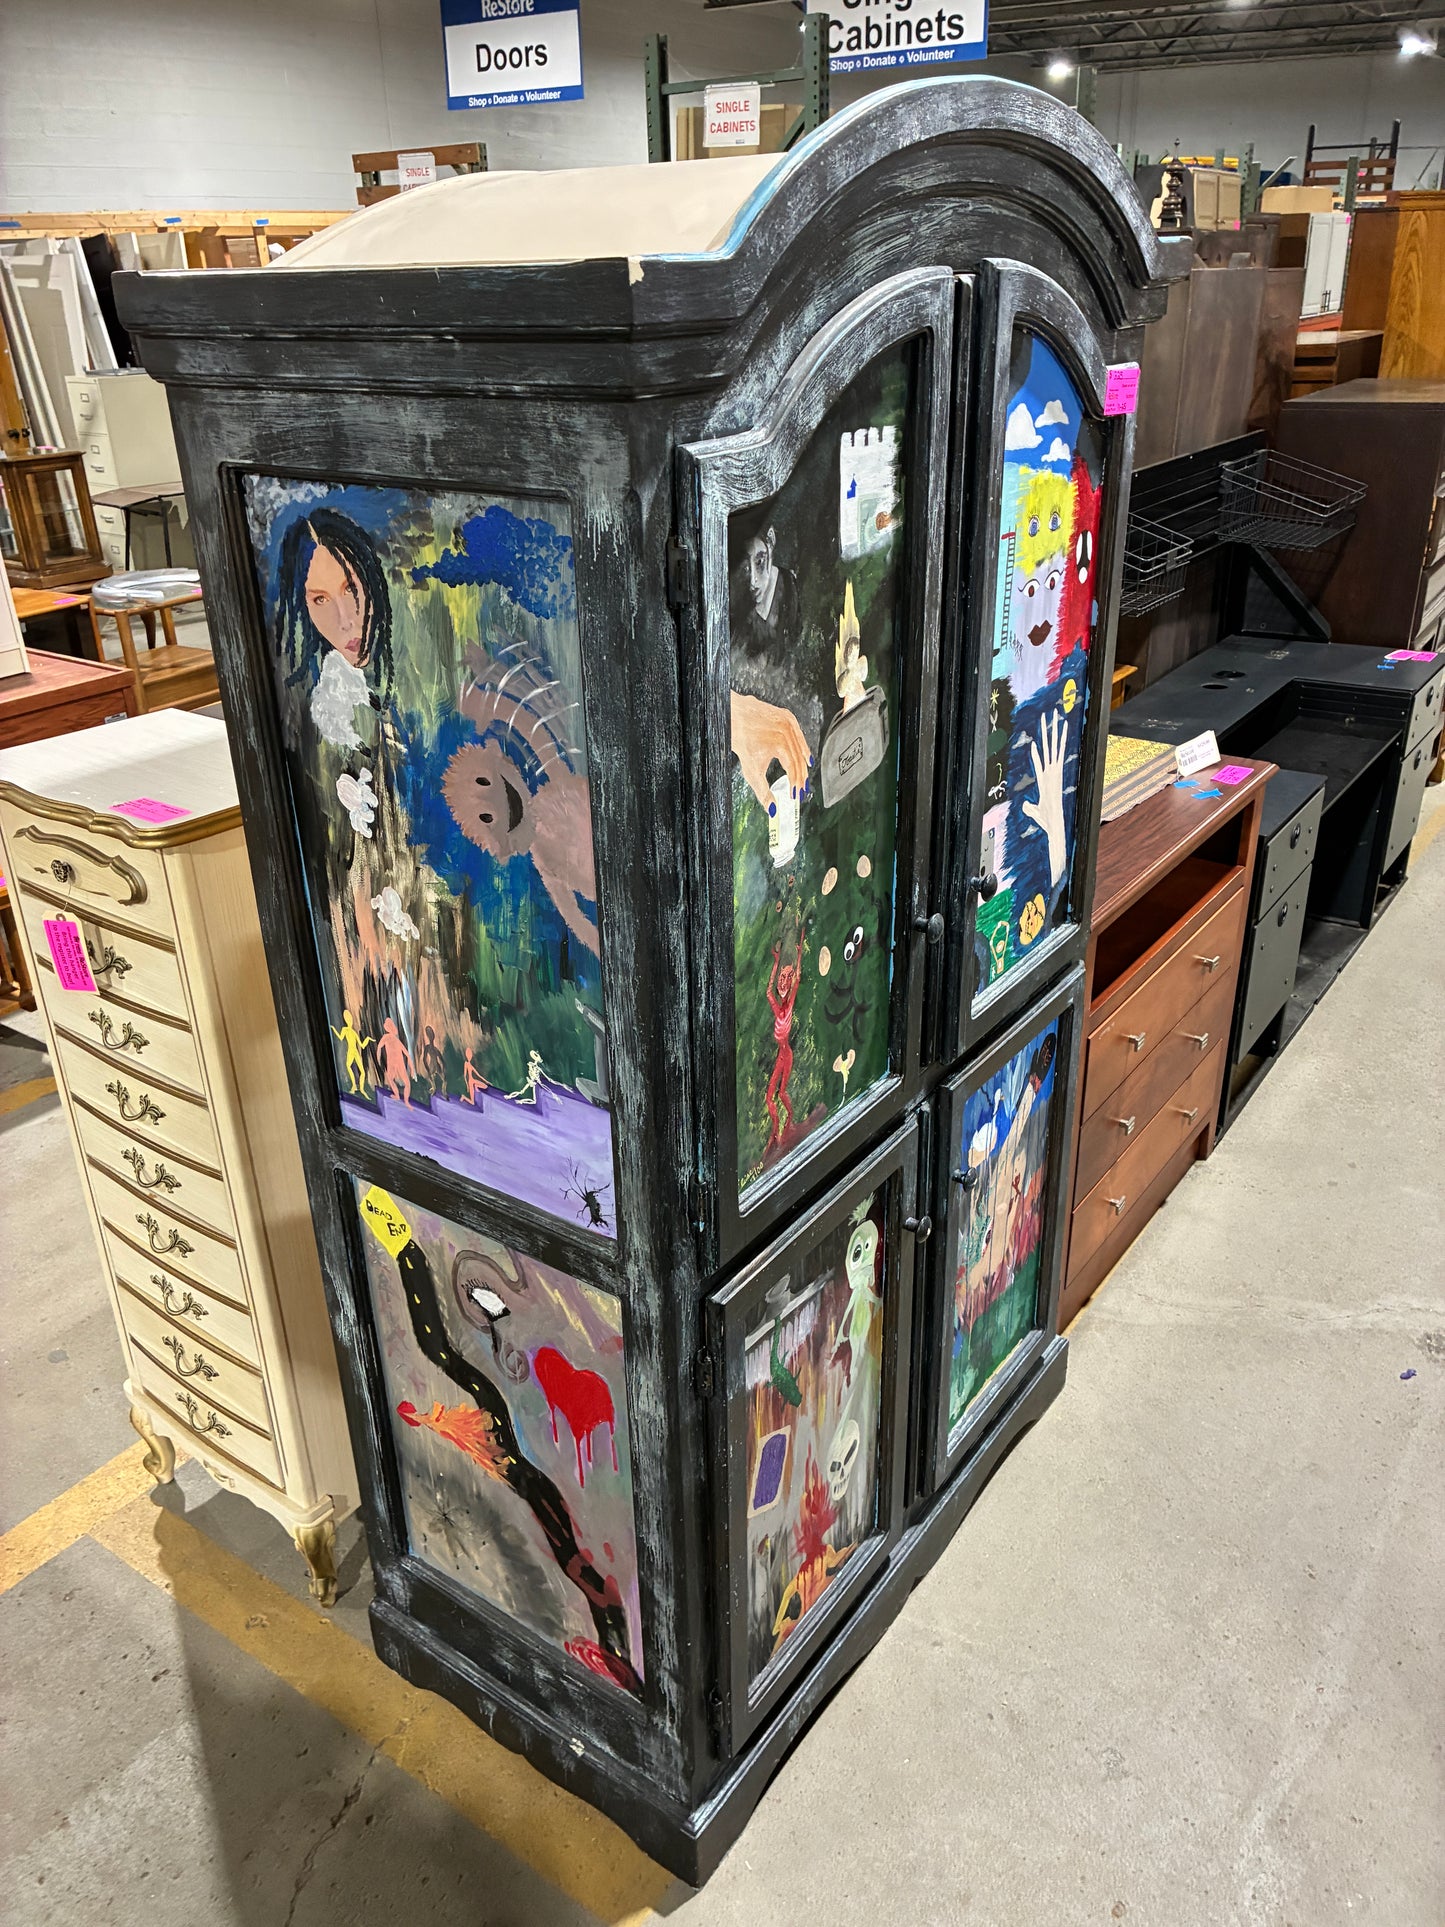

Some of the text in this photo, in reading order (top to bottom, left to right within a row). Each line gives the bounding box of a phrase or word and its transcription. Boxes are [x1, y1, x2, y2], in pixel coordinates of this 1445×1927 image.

[481, 0, 535, 18] ReStore
[829, 8, 964, 54] Cabinets
[476, 43, 548, 73] Doors
[830, 48, 955, 73] Shop Donate Volunteer
[468, 90, 562, 108] Shop Donate Volunteer
[715, 100, 750, 114] SINGLE
[710, 120, 756, 134] CABINETS
[405, 167, 430, 177] SINGLE
[365, 1199, 393, 1221] DEAD
[386, 1222, 407, 1237] END
